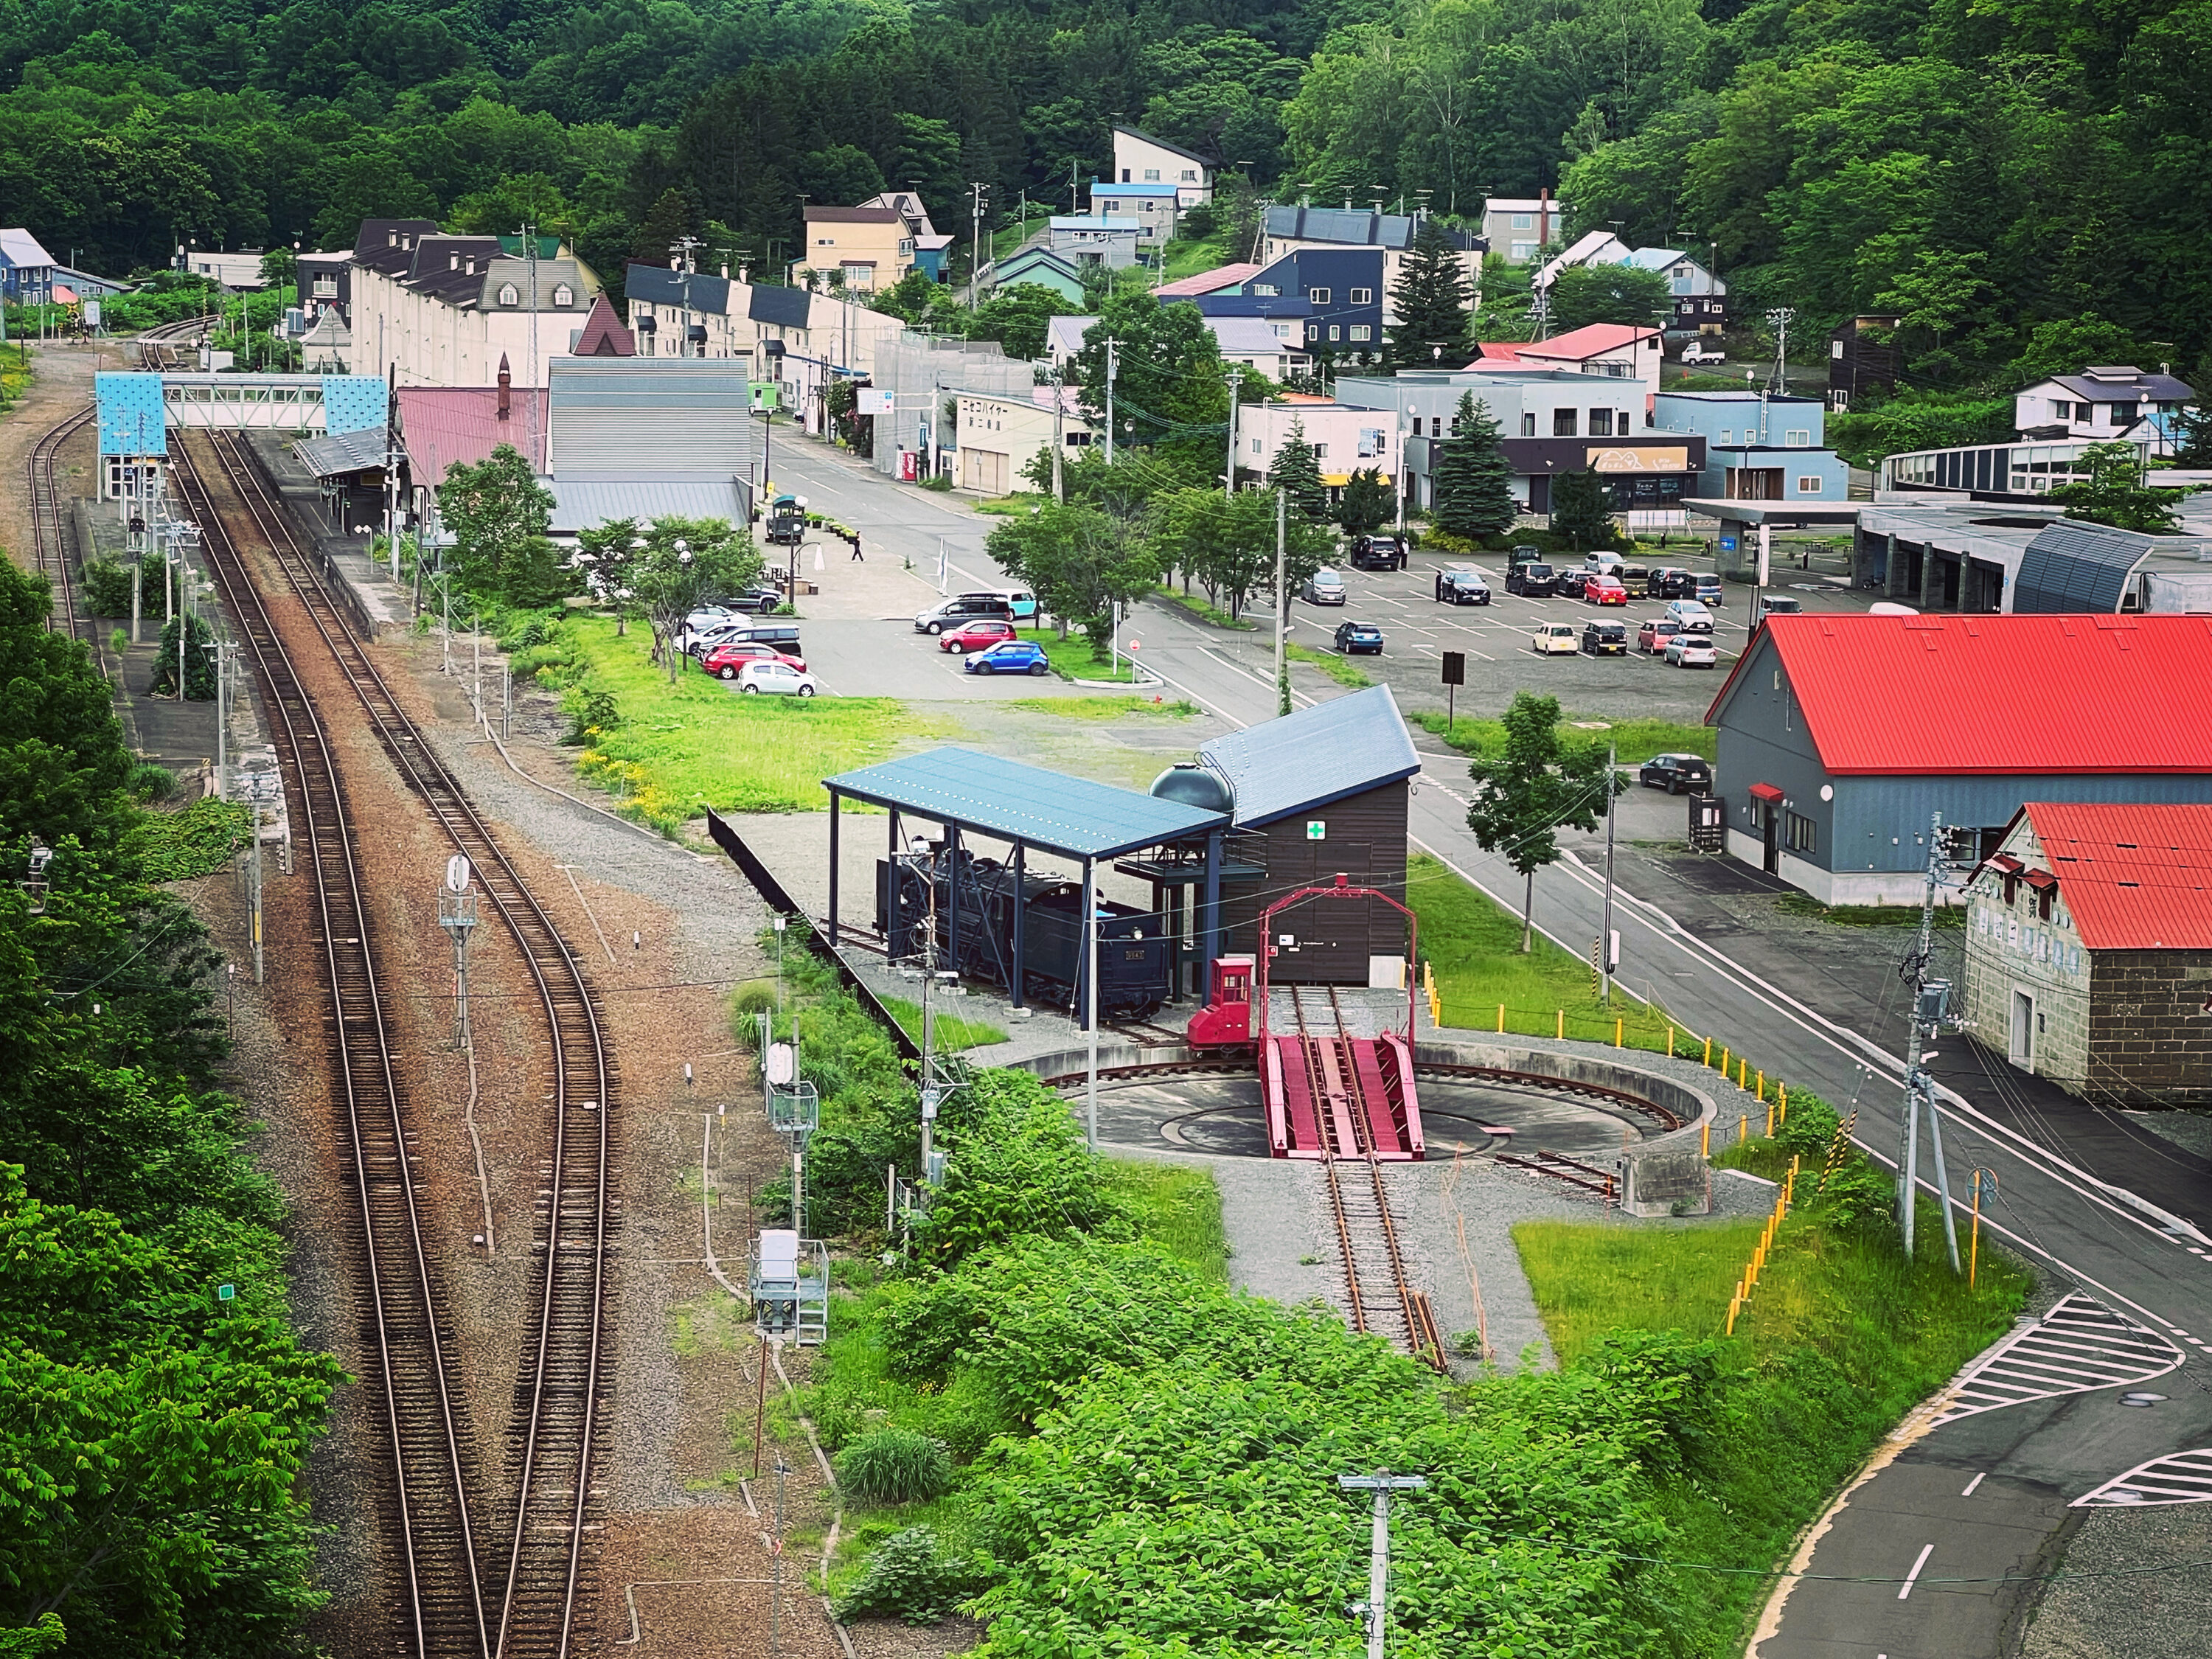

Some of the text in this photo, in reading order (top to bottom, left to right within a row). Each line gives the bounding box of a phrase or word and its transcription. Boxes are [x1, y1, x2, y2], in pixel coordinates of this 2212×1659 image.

[963, 400, 1008, 416] ニセコハイヤー
